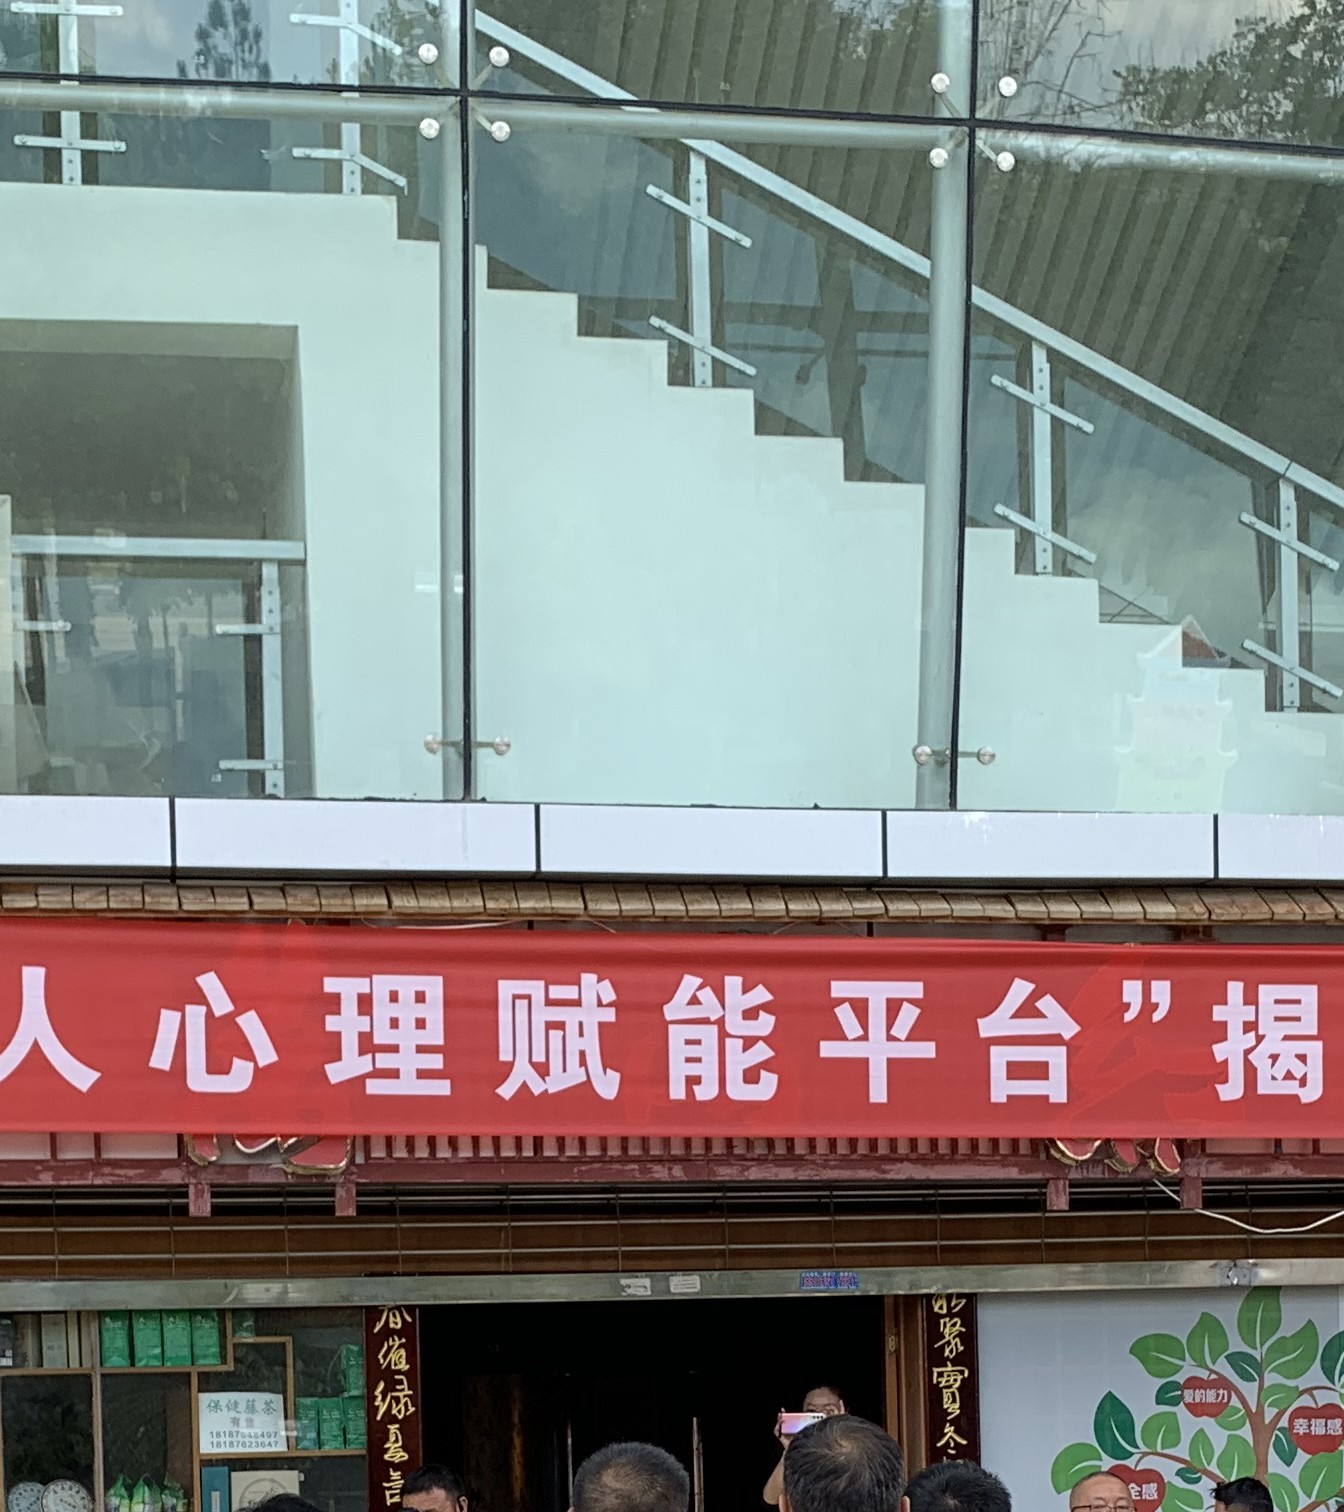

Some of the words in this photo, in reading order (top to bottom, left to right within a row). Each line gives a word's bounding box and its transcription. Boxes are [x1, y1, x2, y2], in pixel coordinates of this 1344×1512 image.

[1183, 1388, 1229, 1404] 爱的能力
[1293, 1418, 1344, 1436] 幸福感
[1128, 1482, 1158, 1500] 全感
